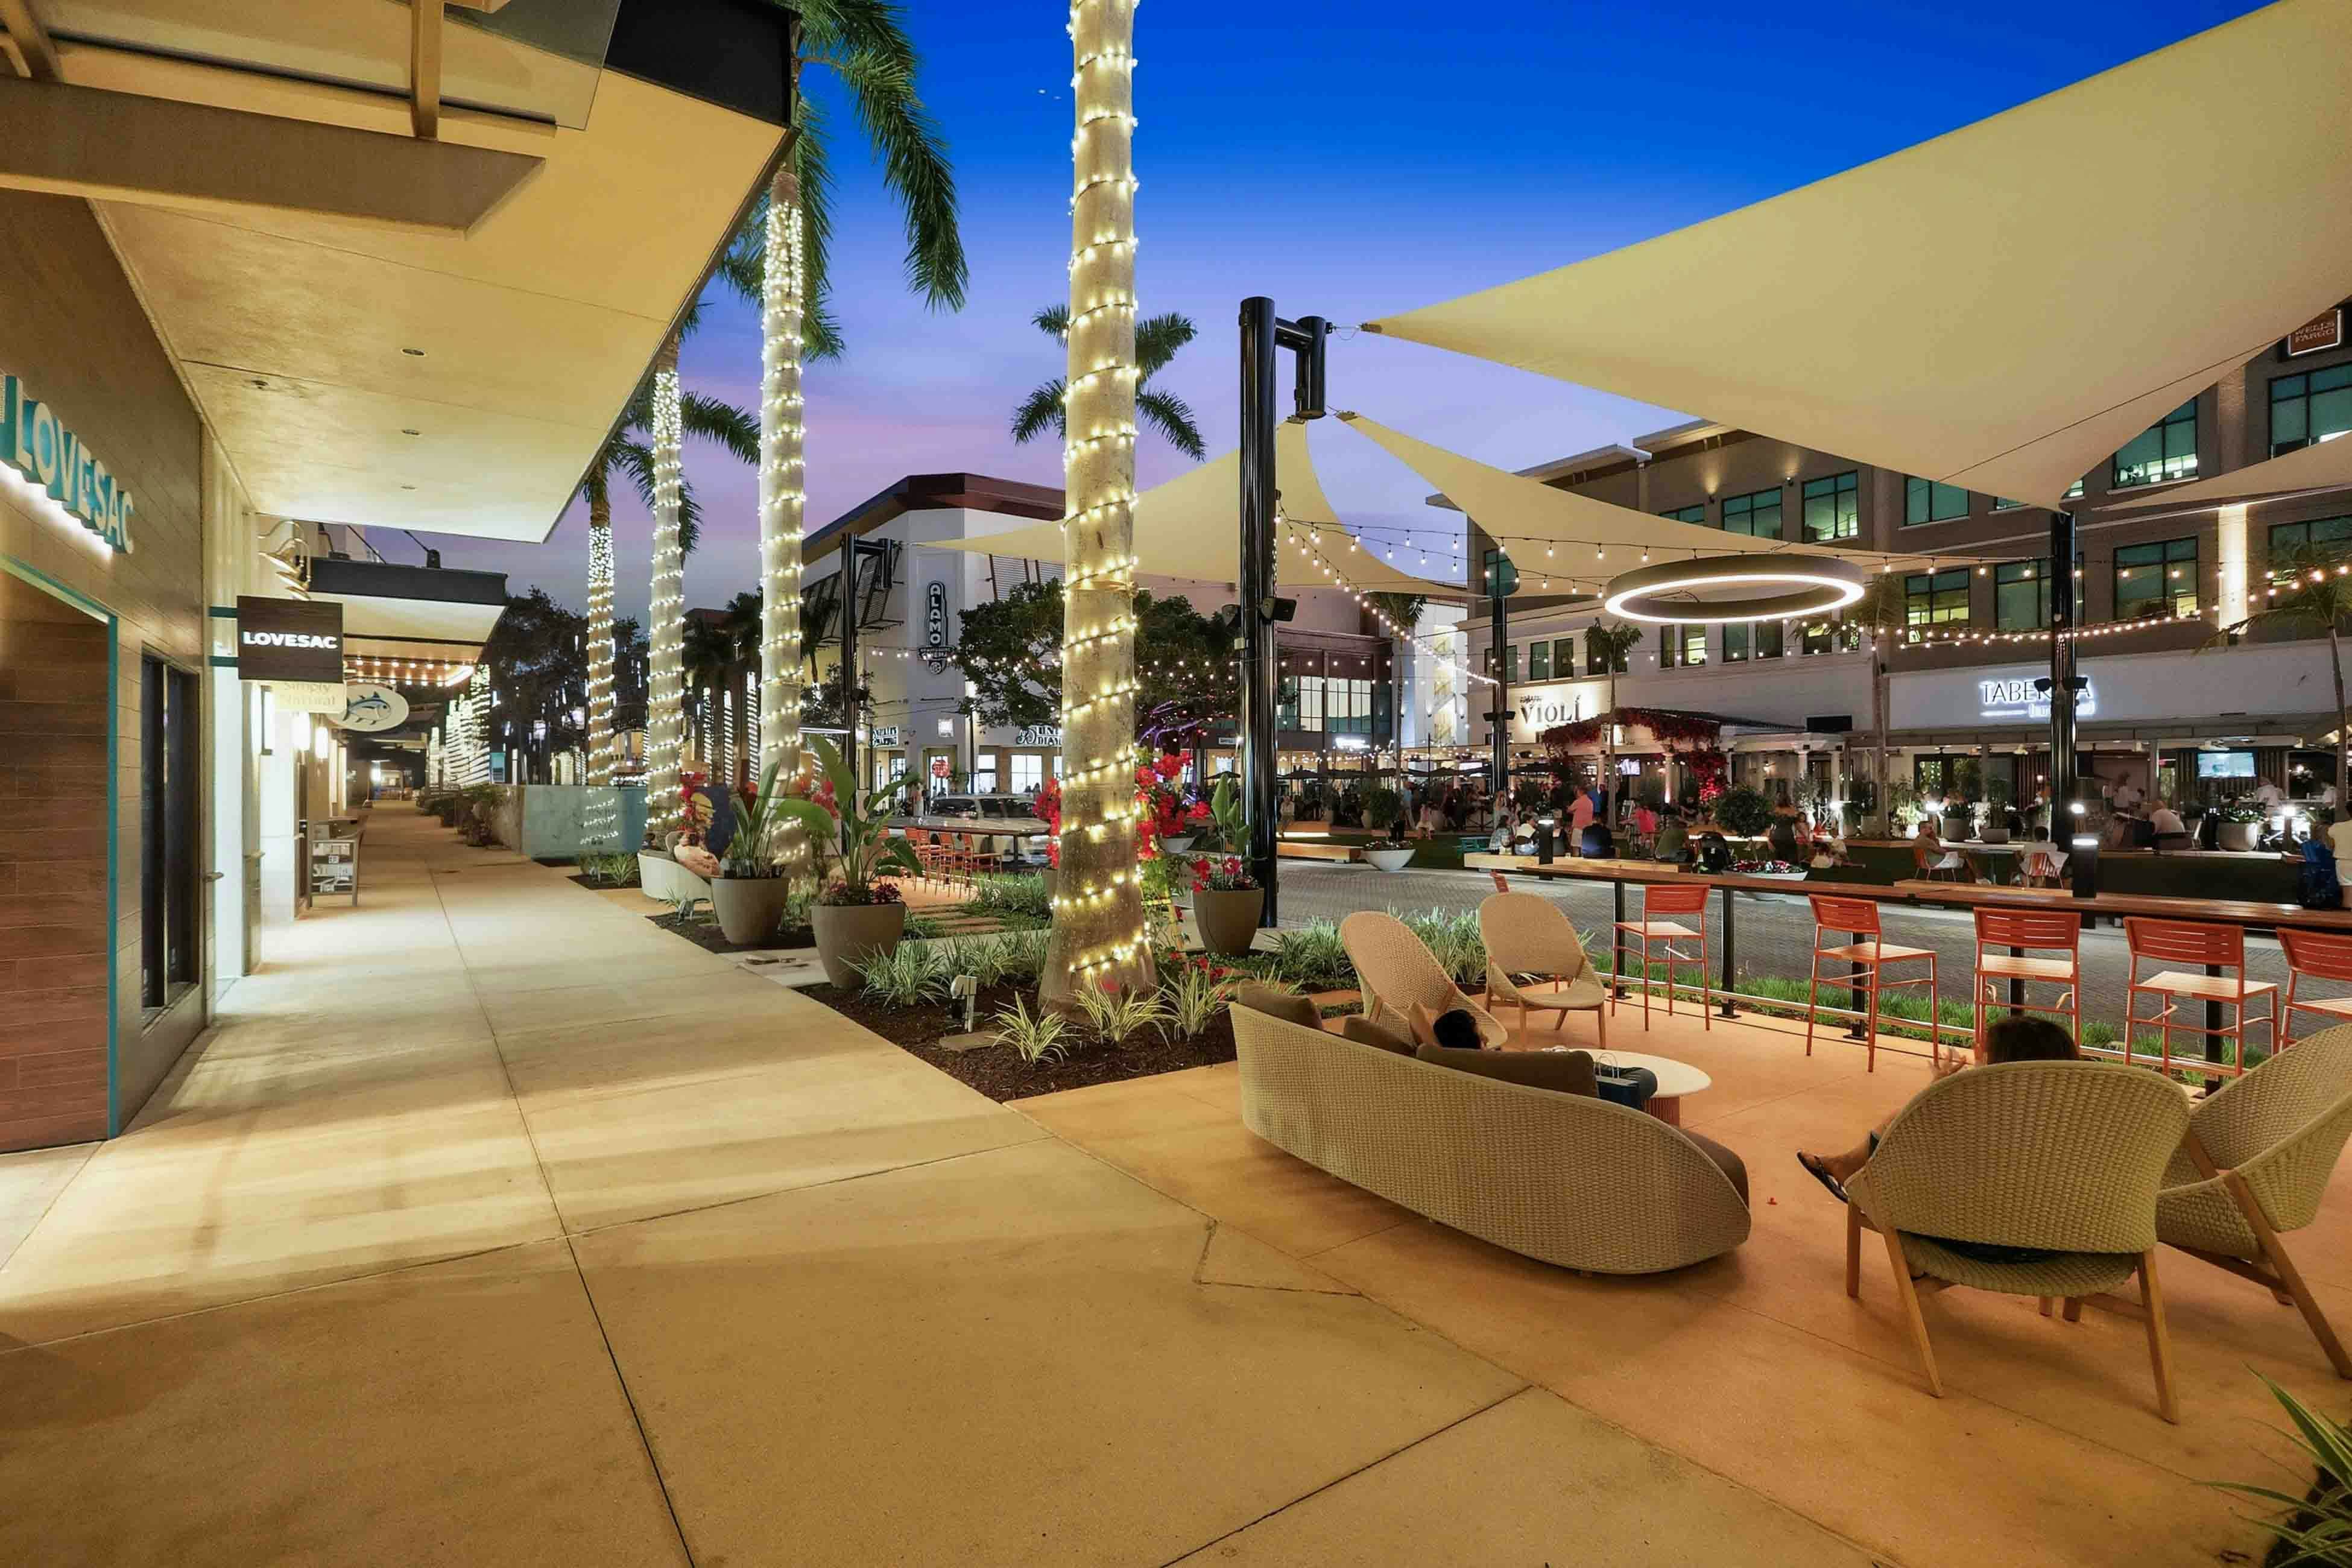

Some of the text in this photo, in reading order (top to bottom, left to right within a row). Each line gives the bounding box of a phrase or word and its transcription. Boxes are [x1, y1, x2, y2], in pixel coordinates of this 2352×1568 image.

[6, 375, 134, 554] LOVESAC
[929, 584, 941, 645] ALAMO
[243, 631, 338, 649] LOVESAC
[1981, 678, 2090, 703] TABE
